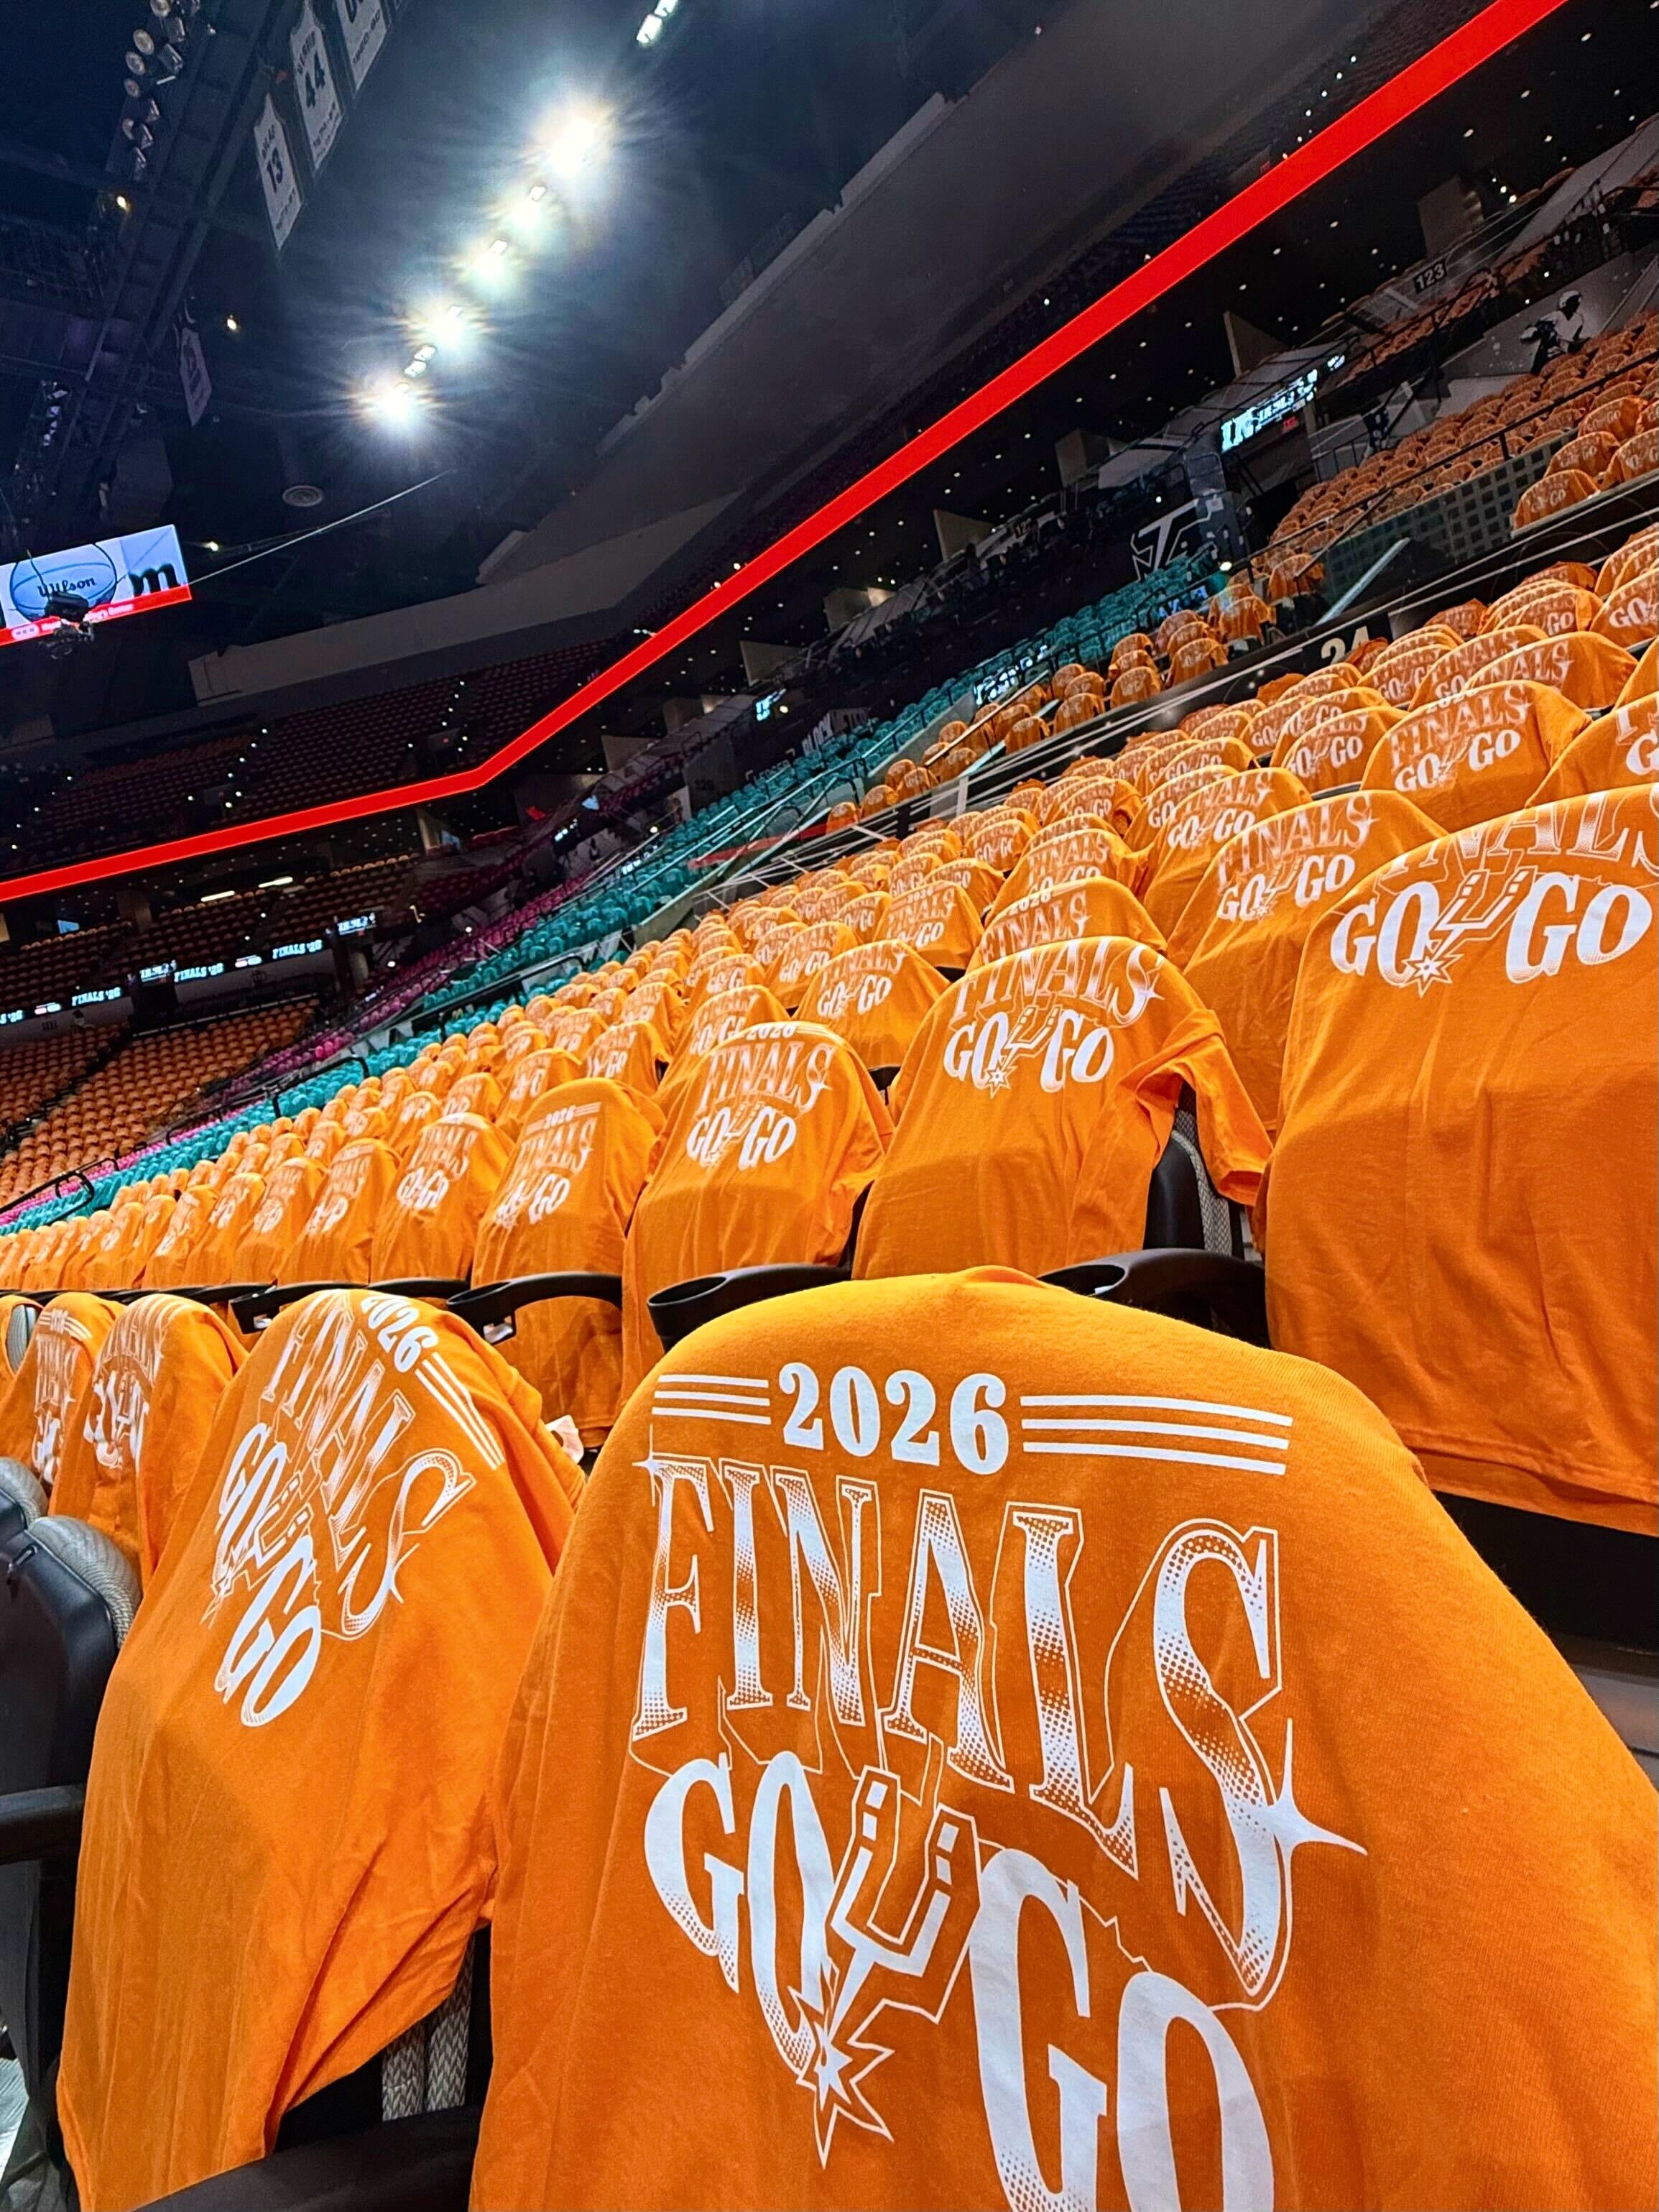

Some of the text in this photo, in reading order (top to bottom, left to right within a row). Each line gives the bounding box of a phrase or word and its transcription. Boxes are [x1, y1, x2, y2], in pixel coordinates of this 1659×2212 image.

[267, 147, 283, 194] 13
[1416, 262, 1445, 290] 123
[37, 576, 96, 597] Wilson
[1609, 597, 1649, 628] GO
[1547, 612, 1575, 636] GO
[1331, 736, 1363, 768] GO
[1390, 682, 1533, 775] FINALS
[1395, 729, 1521, 792] GO GO
[1168, 808, 1255, 849] GO GO
[1217, 854, 1356, 923] GO GO
[272, 942, 306, 960] FINALS
[915, 922, 944, 949] GO
[980, 890, 1092, 964] FINALS
[1331, 872, 1653, 987] GO GO
[71, 990, 105, 1007] FINALS
[174, 965, 207, 983] FINALS
[818, 974, 892, 1020] GO GO
[948, 938, 1165, 1028] FINALS
[697, 1040, 835, 1117] FINALS
[943, 1009, 1114, 1093] GO GO
[687, 1106, 798, 1171] GO GO
[529, 1172, 570, 1225] GO
[360, 1294, 440, 1373] 2026
[779, 1362, 1008, 1475] 2026
[260, 1290, 476, 1641] FINALS
[214, 1532, 321, 1727] GO
[630, 1452, 1286, 2010] FINALS
[644, 1751, 1276, 2212] GO GO
